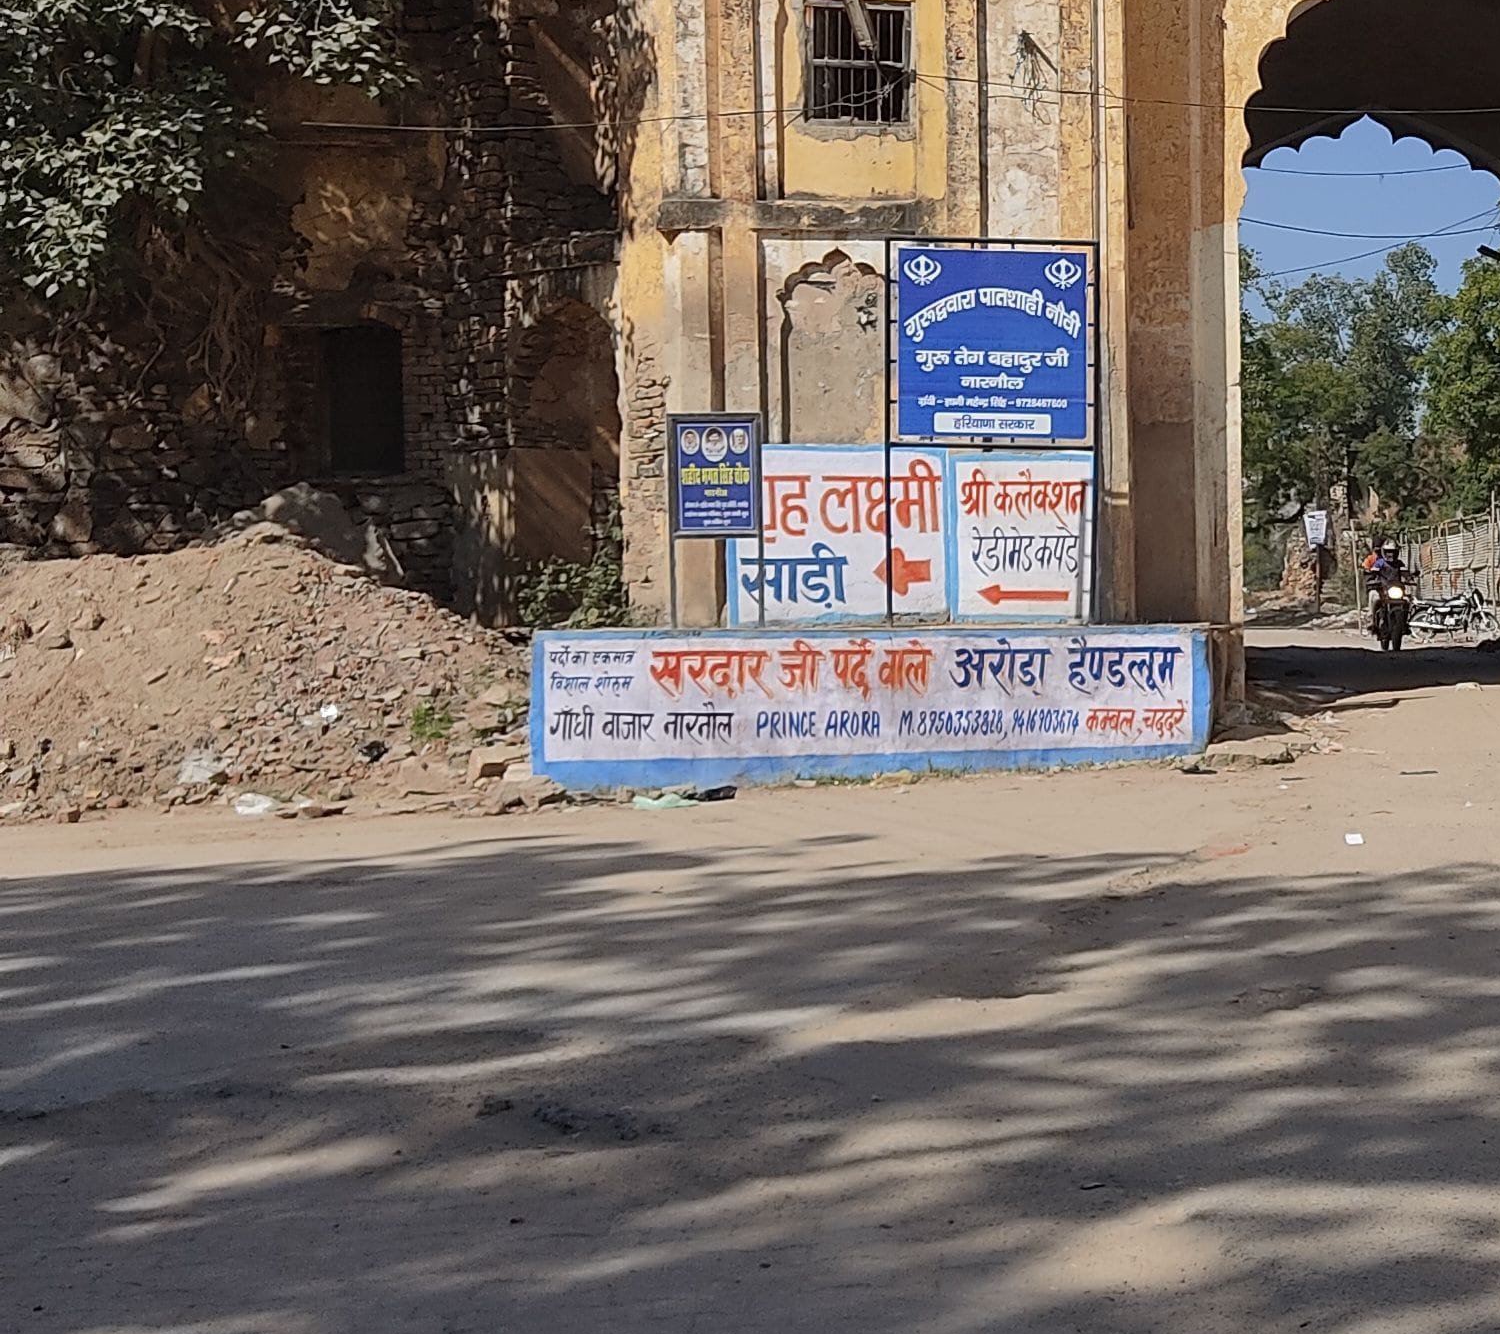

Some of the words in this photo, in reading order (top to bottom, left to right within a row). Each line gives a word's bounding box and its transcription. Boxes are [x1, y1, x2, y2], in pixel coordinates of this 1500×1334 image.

[978, 287, 1044, 317] पातशाही
[915, 349, 951, 372] गुरू
[953, 346, 985, 366] तेग
[1044, 347, 1070, 368] जी
[953, 415, 995, 430] हरियाणा
[999, 418, 1035, 430] सरकार
[960, 468, 994, 518] श्री
[571, 650, 591, 666] का
[650, 650, 773, 700] सरदार
[777, 639, 825, 693] जी
[878, 639, 935, 699] वाले
[755, 710, 817, 739] PRINCE
[825, 709, 881, 738] ARORA
